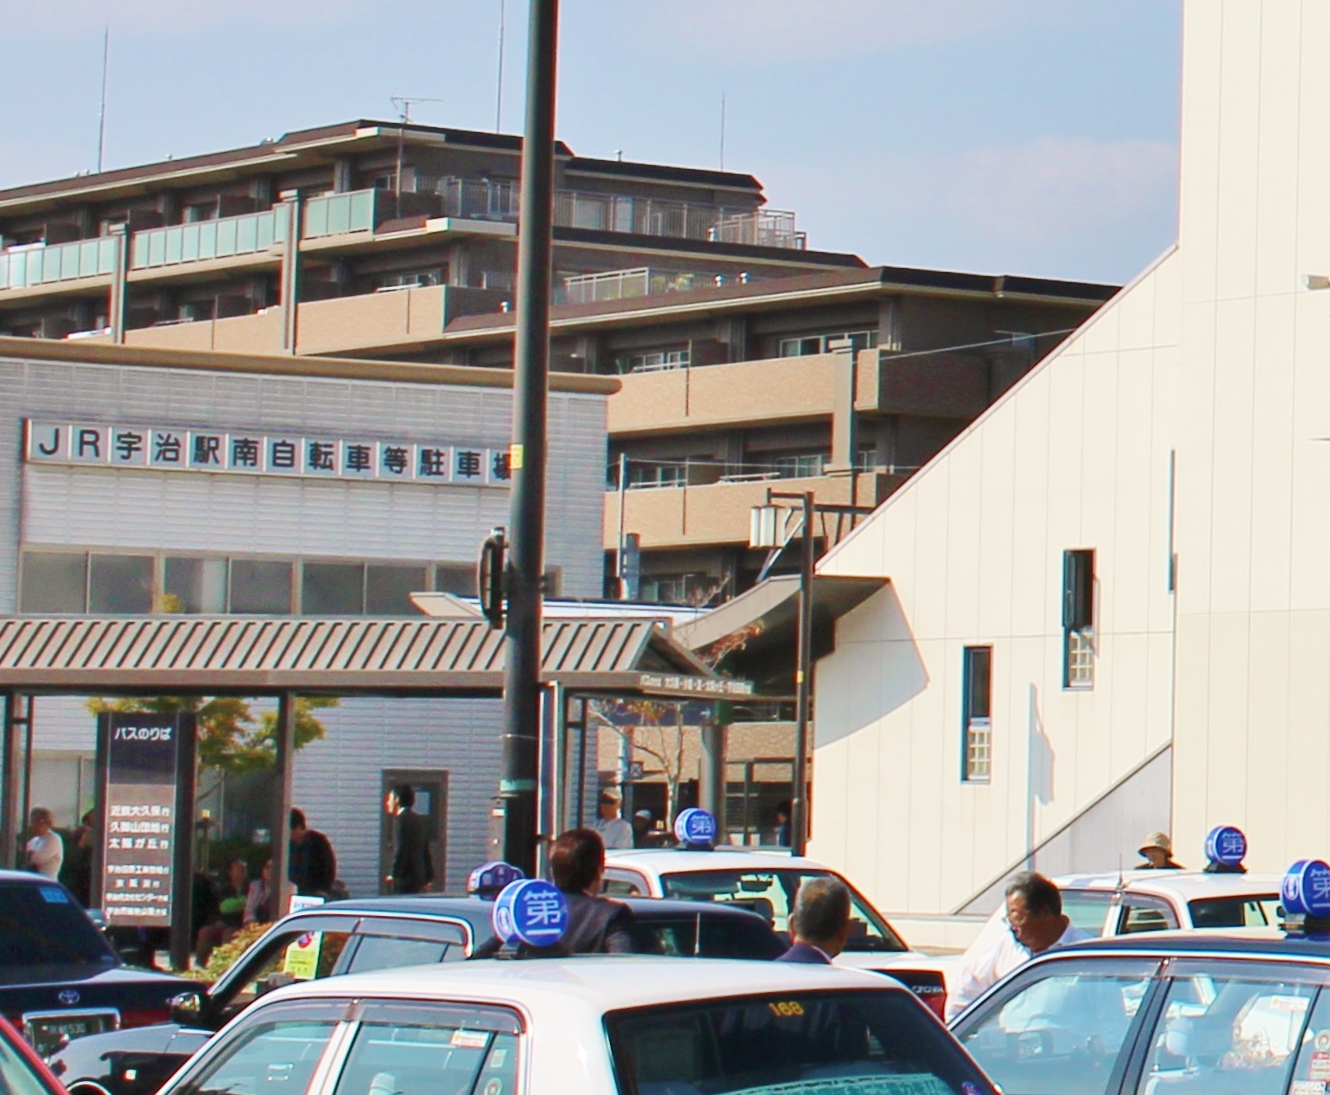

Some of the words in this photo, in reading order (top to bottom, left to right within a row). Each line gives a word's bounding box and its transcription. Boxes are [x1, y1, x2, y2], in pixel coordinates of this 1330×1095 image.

[114, 727, 172, 740] バスのりば
[768, 1001, 804, 1016] 168
